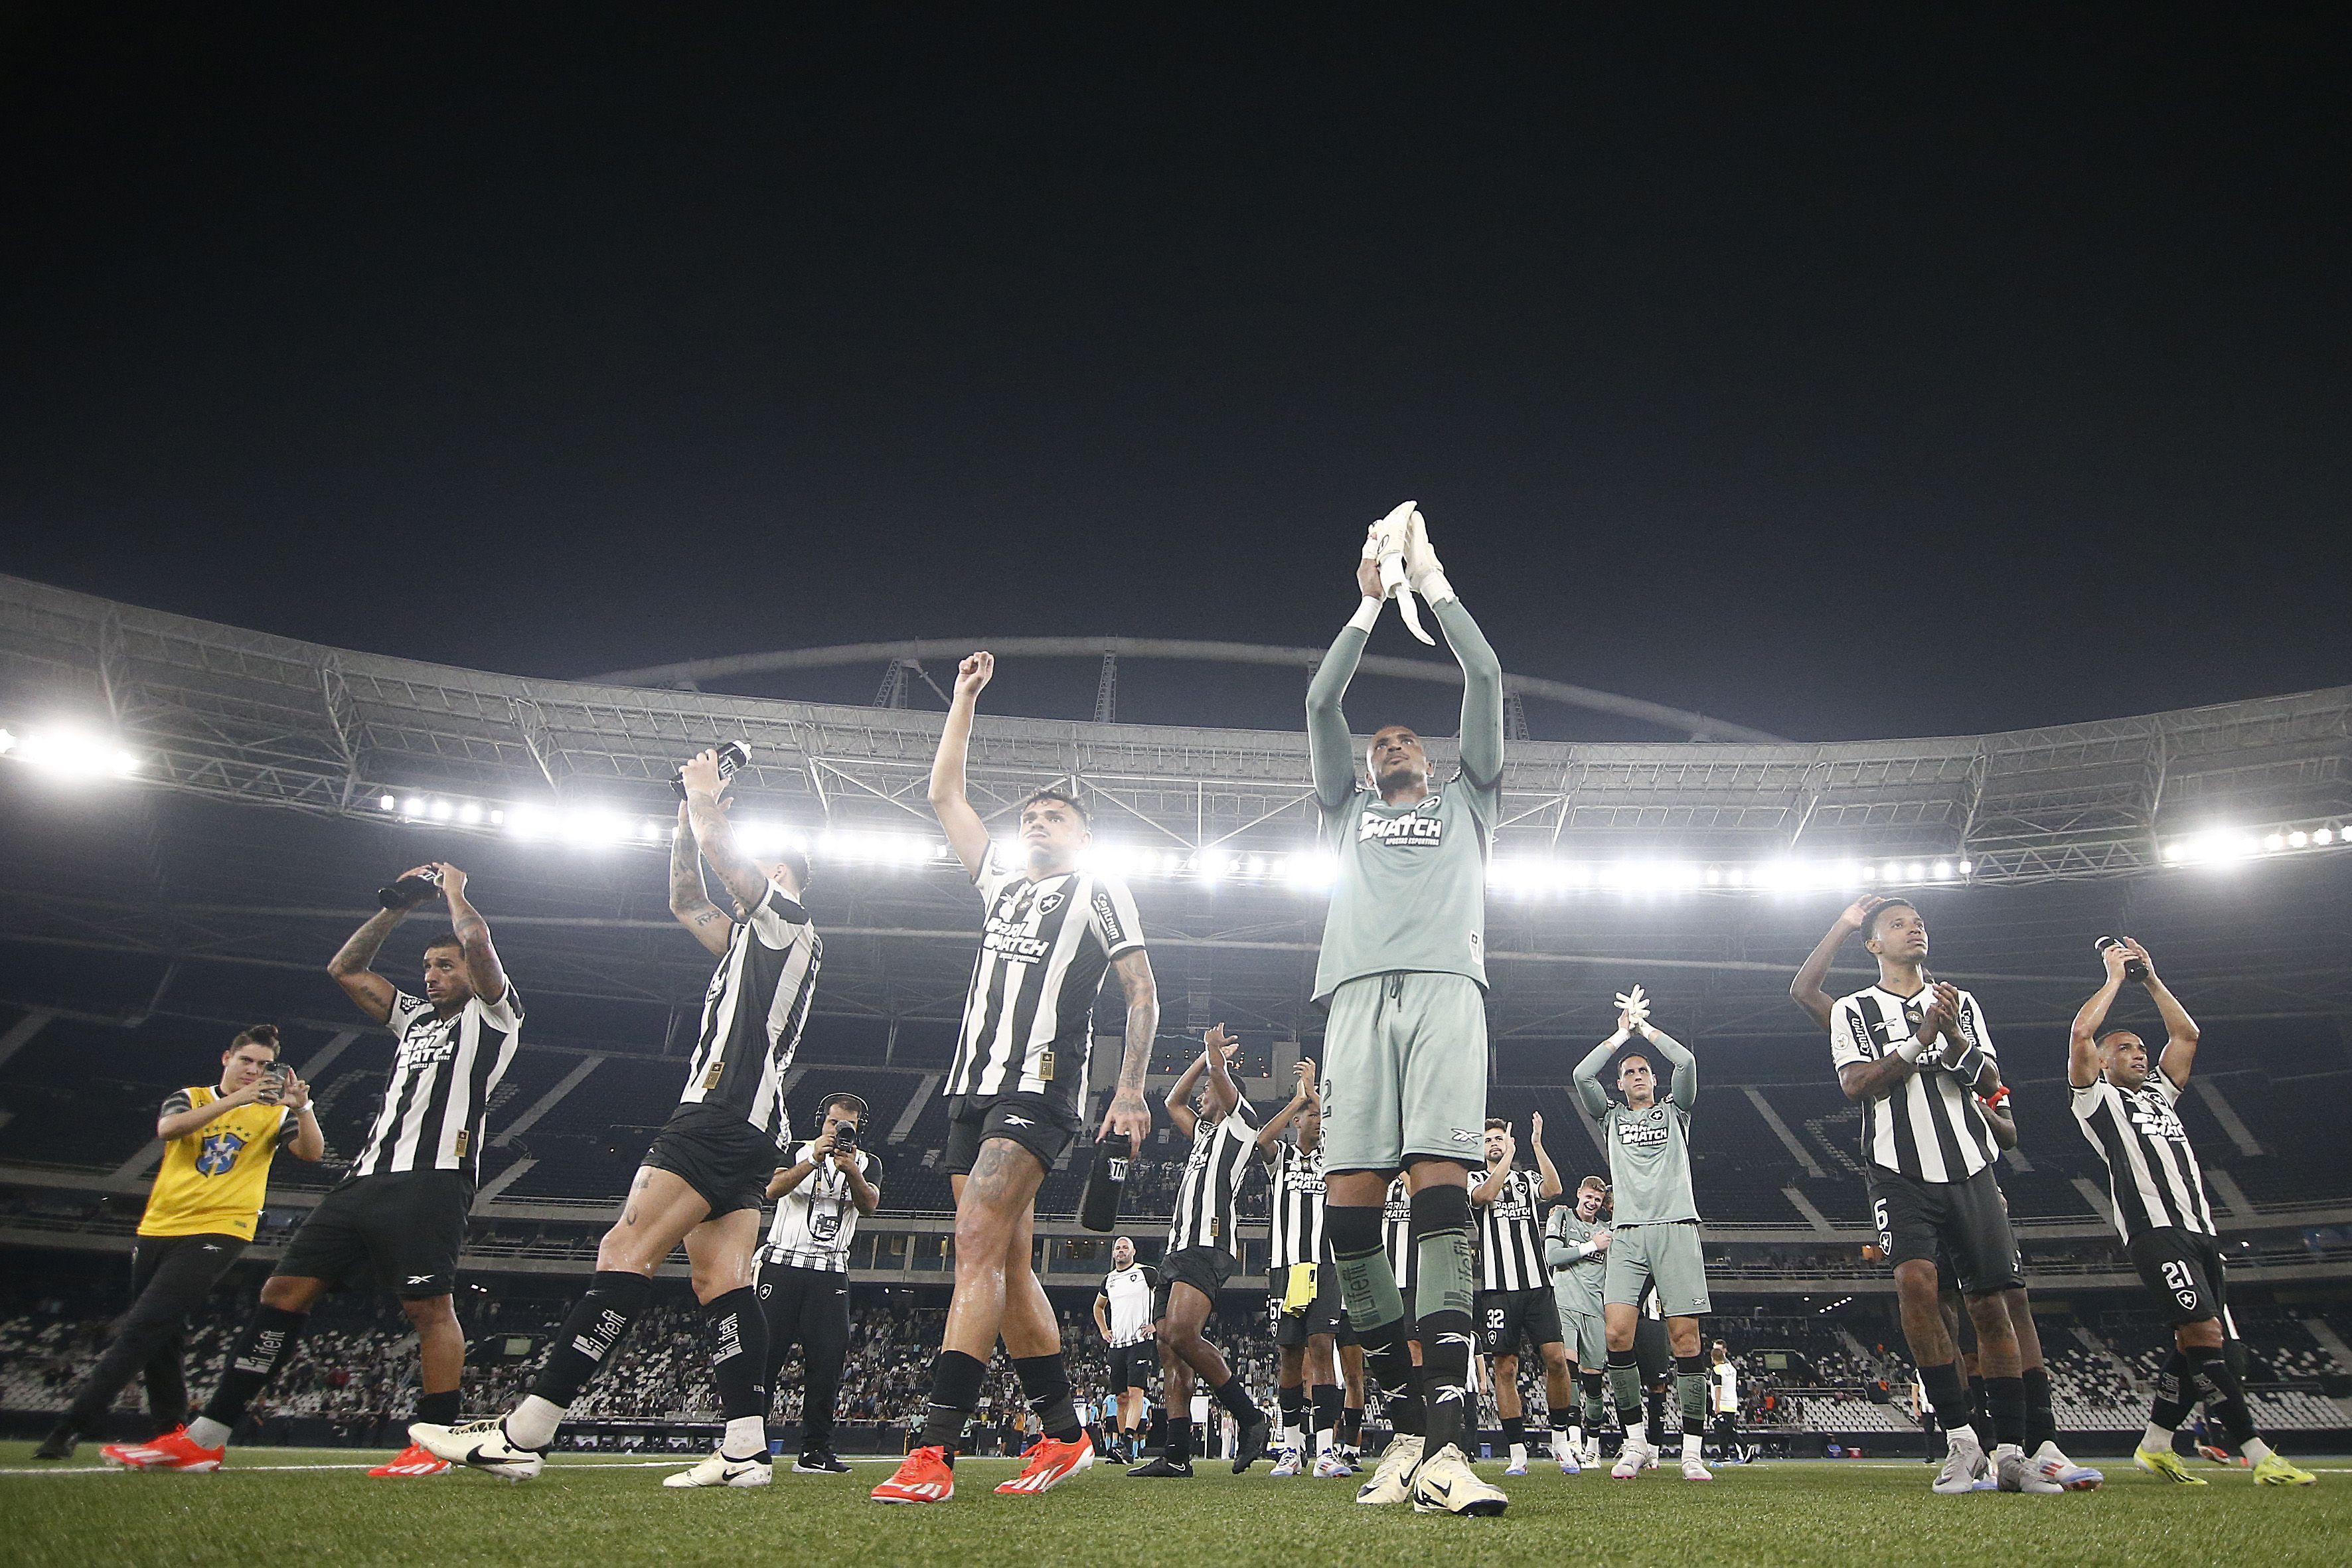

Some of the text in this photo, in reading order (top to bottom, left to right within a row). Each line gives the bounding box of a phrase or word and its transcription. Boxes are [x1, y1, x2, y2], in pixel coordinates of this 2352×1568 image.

[1359, 817, 1442, 842] MATCH
[1097, 893, 1120, 940] Centrum
[983, 933, 1050, 957] MATCH
[1851, 1017, 1869, 1054] Centrum
[1622, 1128, 1668, 1143] MATCH
[2141, 1123, 2184, 1137] MAT
[1283, 1171, 1317, 1181] PARI
[1493, 1207, 1531, 1217] MATCH
[1873, 1197, 1889, 1231] 6
[2161, 1259, 2194, 1290] 21
[1269, 1298, 1284, 1320] 67
[1486, 1308, 1504, 1328] 32
